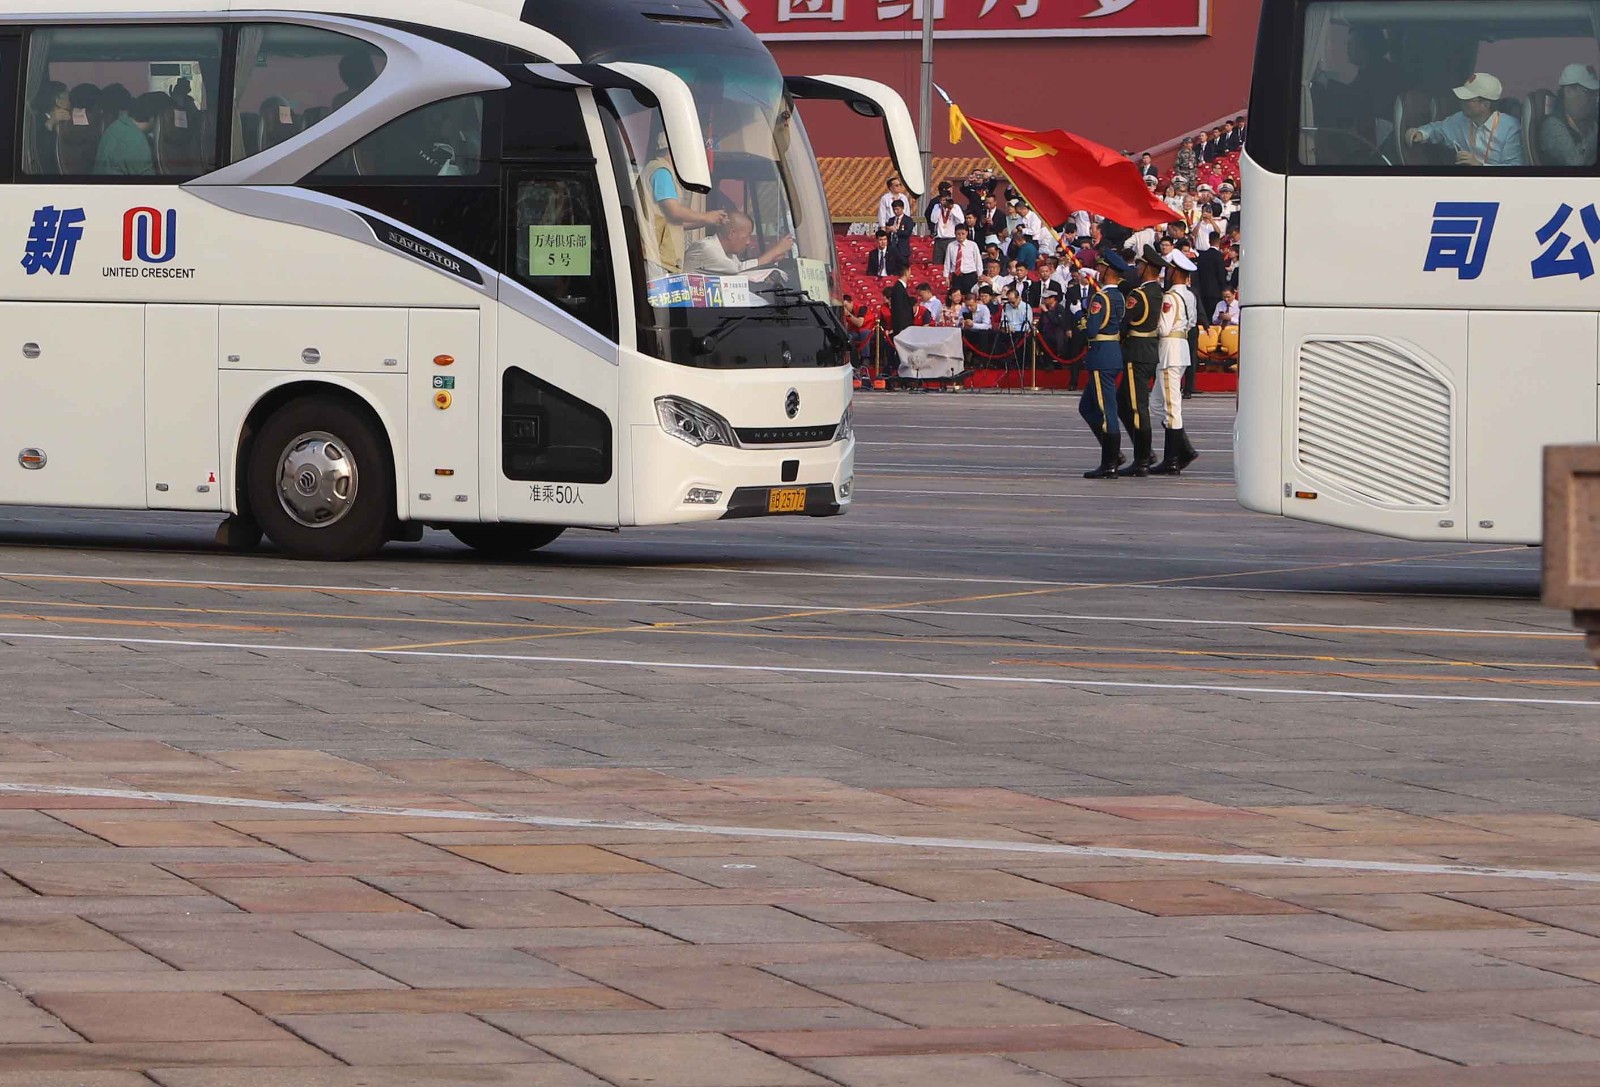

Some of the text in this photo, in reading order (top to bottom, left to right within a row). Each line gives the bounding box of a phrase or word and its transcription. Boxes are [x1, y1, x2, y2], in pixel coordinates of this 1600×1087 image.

[534, 234, 588, 248] 万寿俱乐部
[388, 231, 462, 273] NAVIGATOR
[102, 267, 195, 278] UNITED CRESCENT
[529, 485, 584, 504] 准乘50人
